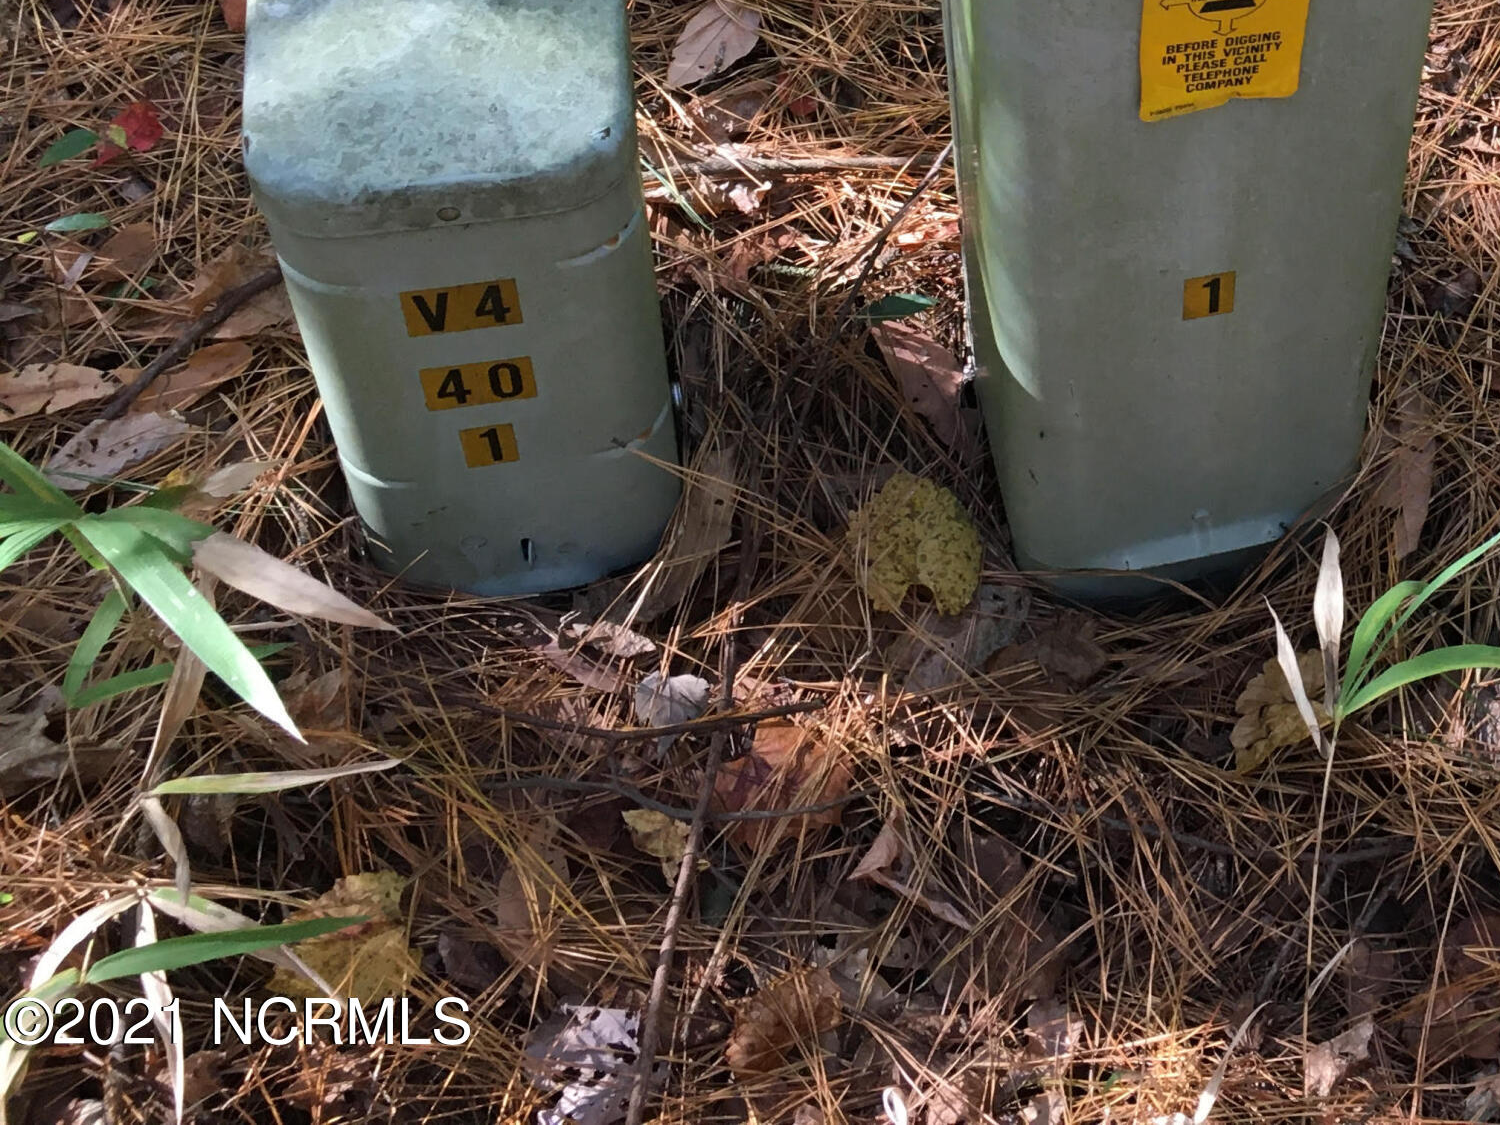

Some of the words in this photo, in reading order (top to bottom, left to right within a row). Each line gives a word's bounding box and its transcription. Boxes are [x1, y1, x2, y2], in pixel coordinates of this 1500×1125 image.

[1162, 55, 1177, 66] IN
[1184, 50, 1216, 63] THIS
[1223, 41, 1283, 58] VICINITY
[1166, 39, 1218, 55] BEFORE
[1225, 31, 1281, 47] DIGGING
[1176, 58, 1227, 74] PLEASE
[1234, 53, 1268, 66] CALL
[1184, 64, 1260, 83] TELEPHONE
[1186, 75, 1254, 94] COMPANY
[1202, 277, 1221, 314] 1
[479, 428, 504, 462] 1
